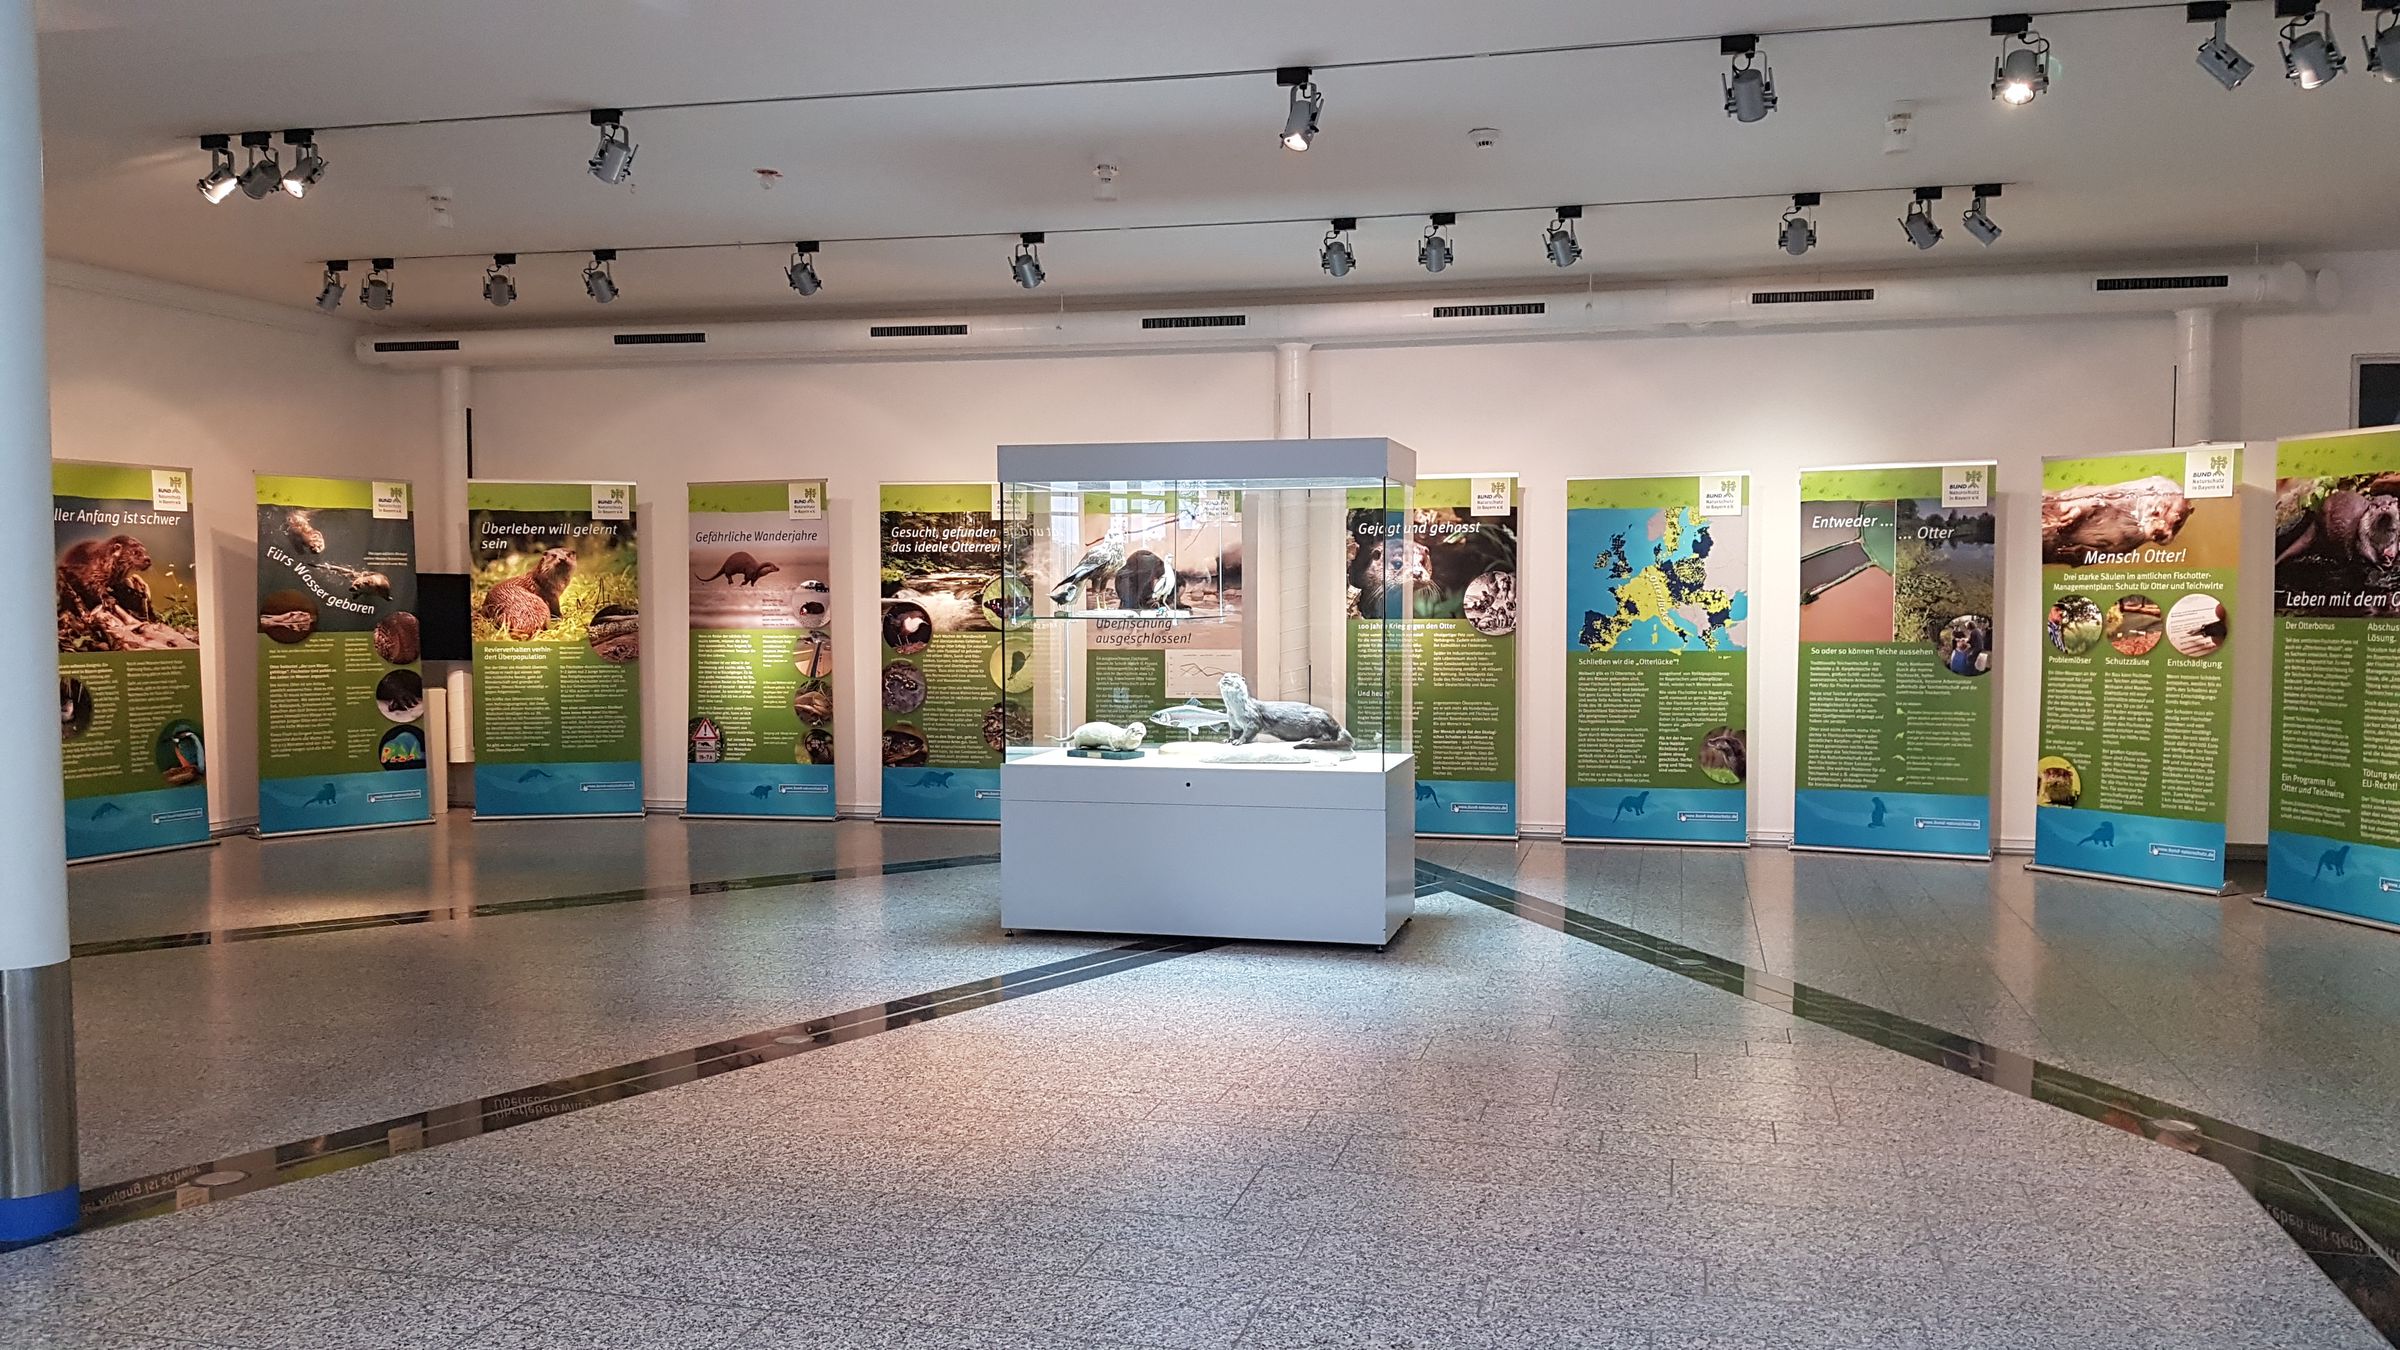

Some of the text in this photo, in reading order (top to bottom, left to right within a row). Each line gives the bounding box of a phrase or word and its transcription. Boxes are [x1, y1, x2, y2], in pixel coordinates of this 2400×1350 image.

[54, 508, 180, 526] ller Anfang ist schwer
[1812, 516, 1878, 528] Entweder
[482, 522, 618, 537] Überleben will gelernt
[891, 526, 996, 540] Gesucht, gefunden
[1358, 522, 1480, 537] Gejagt und gehasst
[1918, 526, 1954, 539] Otter
[482, 538, 508, 549] sein
[696, 530, 817, 544] Gefährliche Wanderjahre
[891, 541, 911, 553] das
[914, 541, 948, 553] ideale
[2084, 548, 2186, 564] Mensch Otter!
[266, 546, 375, 614] Fürs Wasser geboren
[2100, 572, 2125, 580] Säulen
[2137, 572, 2171, 580] amtlichen
[2053, 583, 2114, 592] Managementplan:
[2186, 582, 2223, 590] Teichwirte
[2286, 591, 2326, 607] Leben
[2329, 591, 2351, 606] mit
[2354, 591, 2386, 606] dem
[2298, 622, 2335, 630] Otterbonus
[2368, 623, 2400, 631] Abschus
[1096, 632, 1192, 646] ausgeschlossen!
[2049, 656, 2092, 664] Problemlöser
[2105, 657, 2150, 666] Schutzzäune
[2167, 659, 2223, 669] Entschädigung
[2282, 773, 2336, 786] Ein Programm für
[2363, 768, 2387, 780] Tötung
[2281, 784, 2344, 798] Otter und Teichwirte
